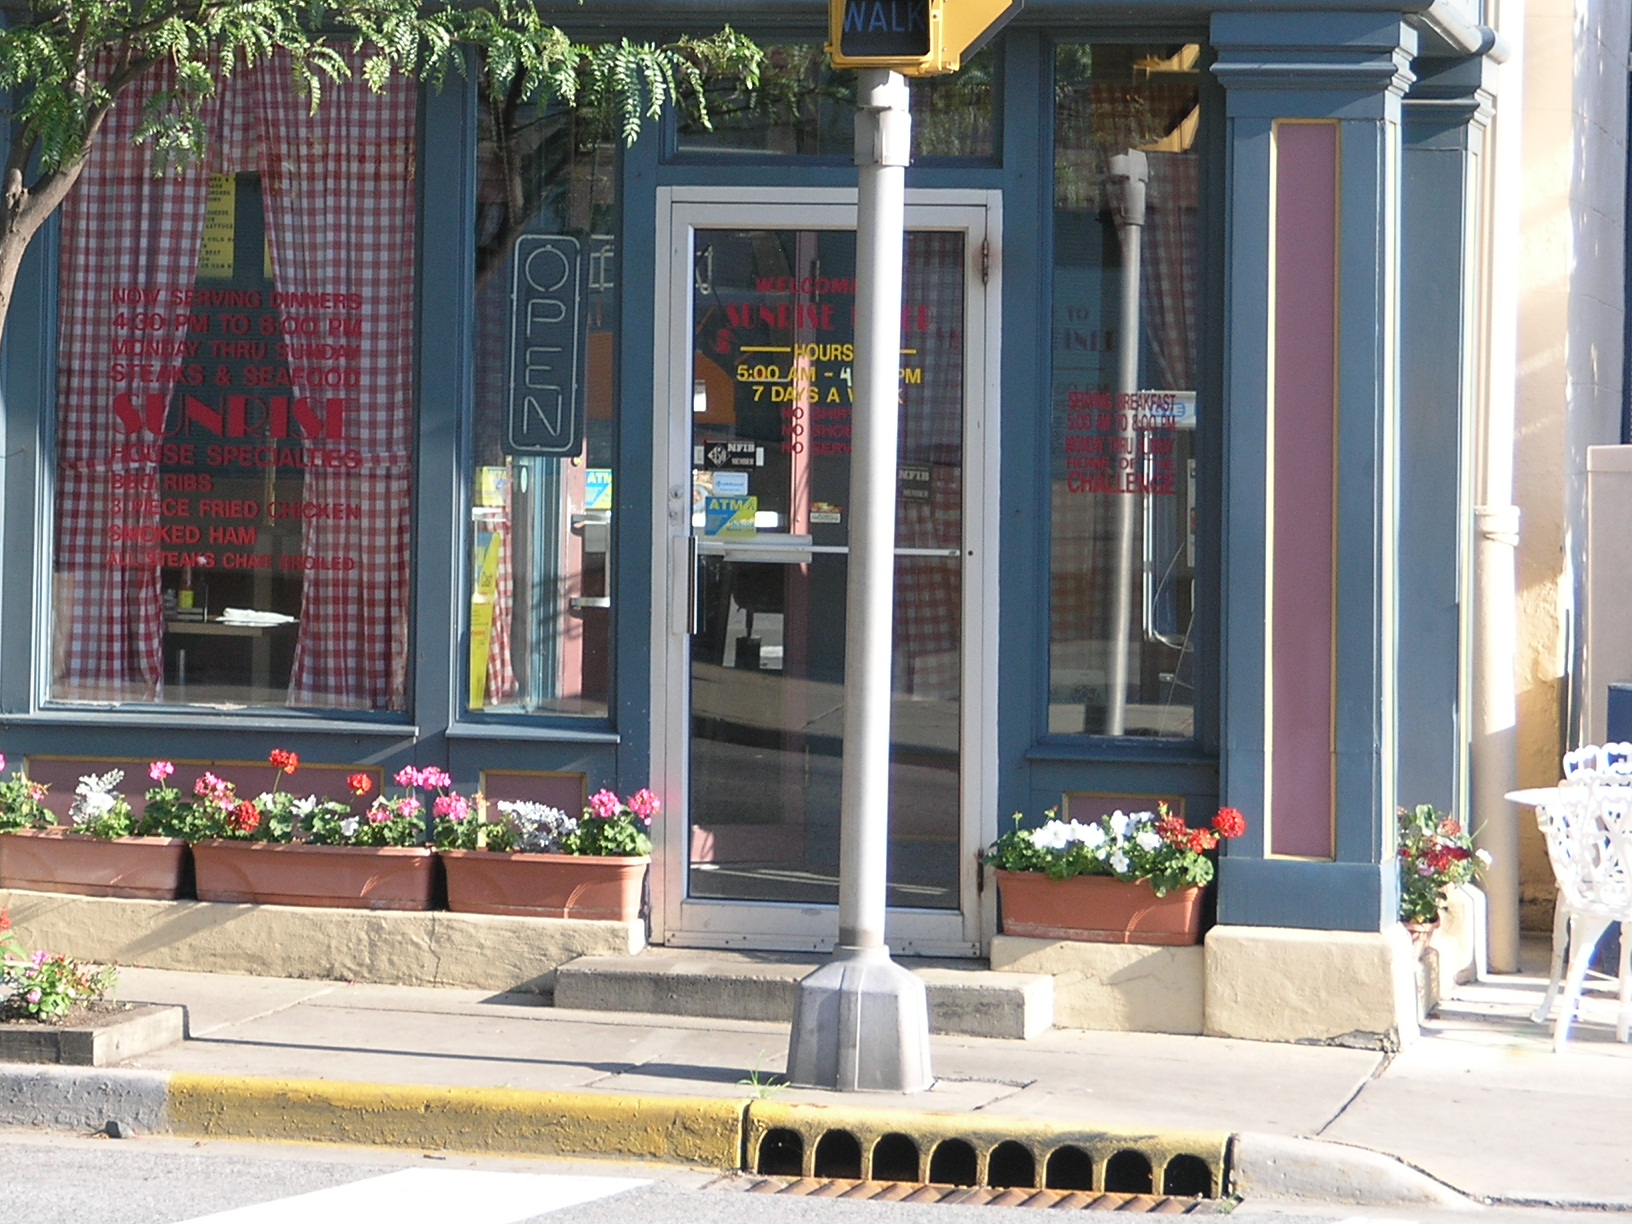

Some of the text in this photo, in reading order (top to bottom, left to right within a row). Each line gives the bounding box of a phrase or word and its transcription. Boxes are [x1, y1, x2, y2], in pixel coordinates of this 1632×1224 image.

[844, 1, 924, 33] WALK
[112, 288, 362, 310] NOW SERVING DINNERS
[112, 313, 362, 337] 4:30 PM TO 8:00 PM
[727, 303, 837, 331] SUNRISE
[111, 339, 361, 361] MONDAY THRU SUNDAY
[523, 244, 569, 437] OPEN
[794, 344, 855, 362] HOURS
[111, 364, 361, 388] STEAKS & SEAFOOD
[736, 365, 780, 382] 5:00
[787, 366, 816, 382] AM
[752, 386, 765, 402] 7
[771, 386, 819, 403] DAYS
[826, 387, 840, 403] A
[1068, 391, 1113, 410] SERVING
[1117, 393, 1176, 411] BREAKFAST
[113, 392, 361, 440] SUNRISE
[780, 407, 804, 420] NO
[1116, 414, 1128, 432] TO
[1160, 415, 1177, 433] PM
[780, 423, 804, 437] NO
[111, 443, 363, 469] HOUSE SPECIALTIES
[780, 441, 804, 454] NO
[1109, 437, 1134, 455] THRU
[1066, 458, 1111, 470] HOME
[1119, 458, 1137, 470] OF
[164, 474, 213, 492] RIBS
[1067, 470, 1176, 495] CHALLENGE
[111, 499, 361, 520] 3 PIECE FRIED CHICKEN
[709, 498, 741, 511] ATM
[108, 524, 256, 545] SMOKED HAM
[106, 552, 355, 571] ALL STEAKS CHAR BROILED
